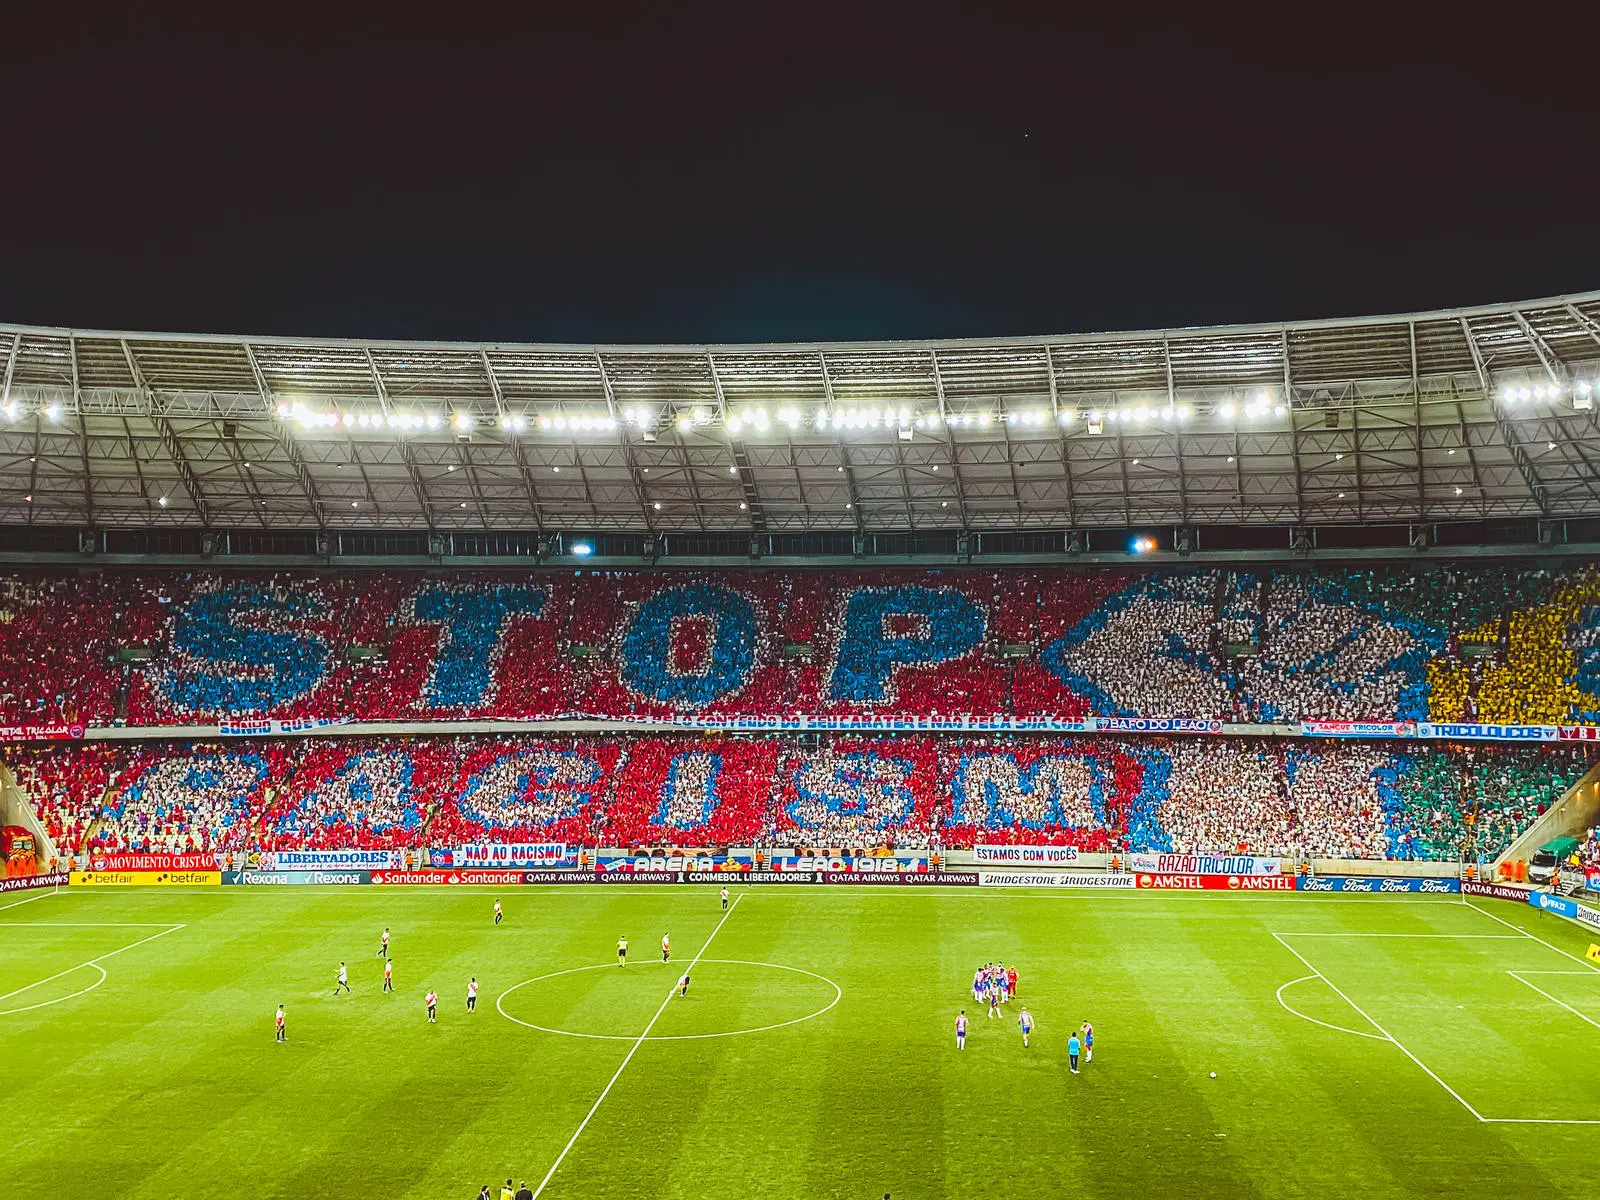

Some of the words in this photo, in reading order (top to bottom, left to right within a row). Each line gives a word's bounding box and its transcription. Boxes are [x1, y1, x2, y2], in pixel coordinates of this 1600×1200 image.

[220, 720, 271, 734] SONHO
[781, 714, 800, 728] DO
[918, 716, 927, 728] E
[1110, 719, 1146, 729] BAFO
[1149, 719, 1169, 730] DO
[26, 726, 69, 735] TRICOLOR
[1432, 725, 1542, 738] TRICOLOUCOS
[278, 852, 389, 864] LIBERTADORES
[492, 846, 507, 860] AO
[511, 845, 563, 860] RACISMO
[977, 849, 1020, 861] ESTAMOS
[1024, 850, 1044, 861] COM
[1047, 847, 1077, 861] VOCÊS
[109, 856, 170, 868] MOVIMENTO
[173, 853, 213, 868] CRISTÃO
[634, 857, 714, 871] ARENA
[29, 874, 68, 886] AIRWAYS
[95, 873, 133, 883] betfair
[171, 873, 209, 883] betfair
[243, 872, 287, 884] Rexona
[315, 872, 360, 884] Rexona
[384, 872, 446, 884] Santander
[461, 872, 522, 884] Santander
[526, 873, 556, 882] QATAR
[558, 873, 596, 882] AIRWAYS
[601, 873, 630, 882] QATAR
[633, 873, 671, 882] AIRWAYS
[689, 873, 742, 882] CONMEBOL
[744, 873, 811, 882] LIBERTADORES
[830, 874, 860, 883] QATAR
[862, 874, 900, 883] AIRWAYS
[905, 874, 936, 883] QATAR
[938, 874, 976, 883] AIRWAYS
[985, 874, 1056, 885] BRIDGESTONE
[1060, 875, 1132, 886] BRIDGESTONE
[1154, 876, 1203, 888] AMSTEL
[1241, 876, 1292, 889] AMSTEL
[1303, 878, 1333, 891] Ford
[1342, 878, 1372, 891] Ford
[1379, 879, 1411, 892] Ford
[1419, 880, 1450, 893] Ford
[1464, 883, 1492, 894] QATAR
[1496, 887, 1531, 900] AIRWAYS
